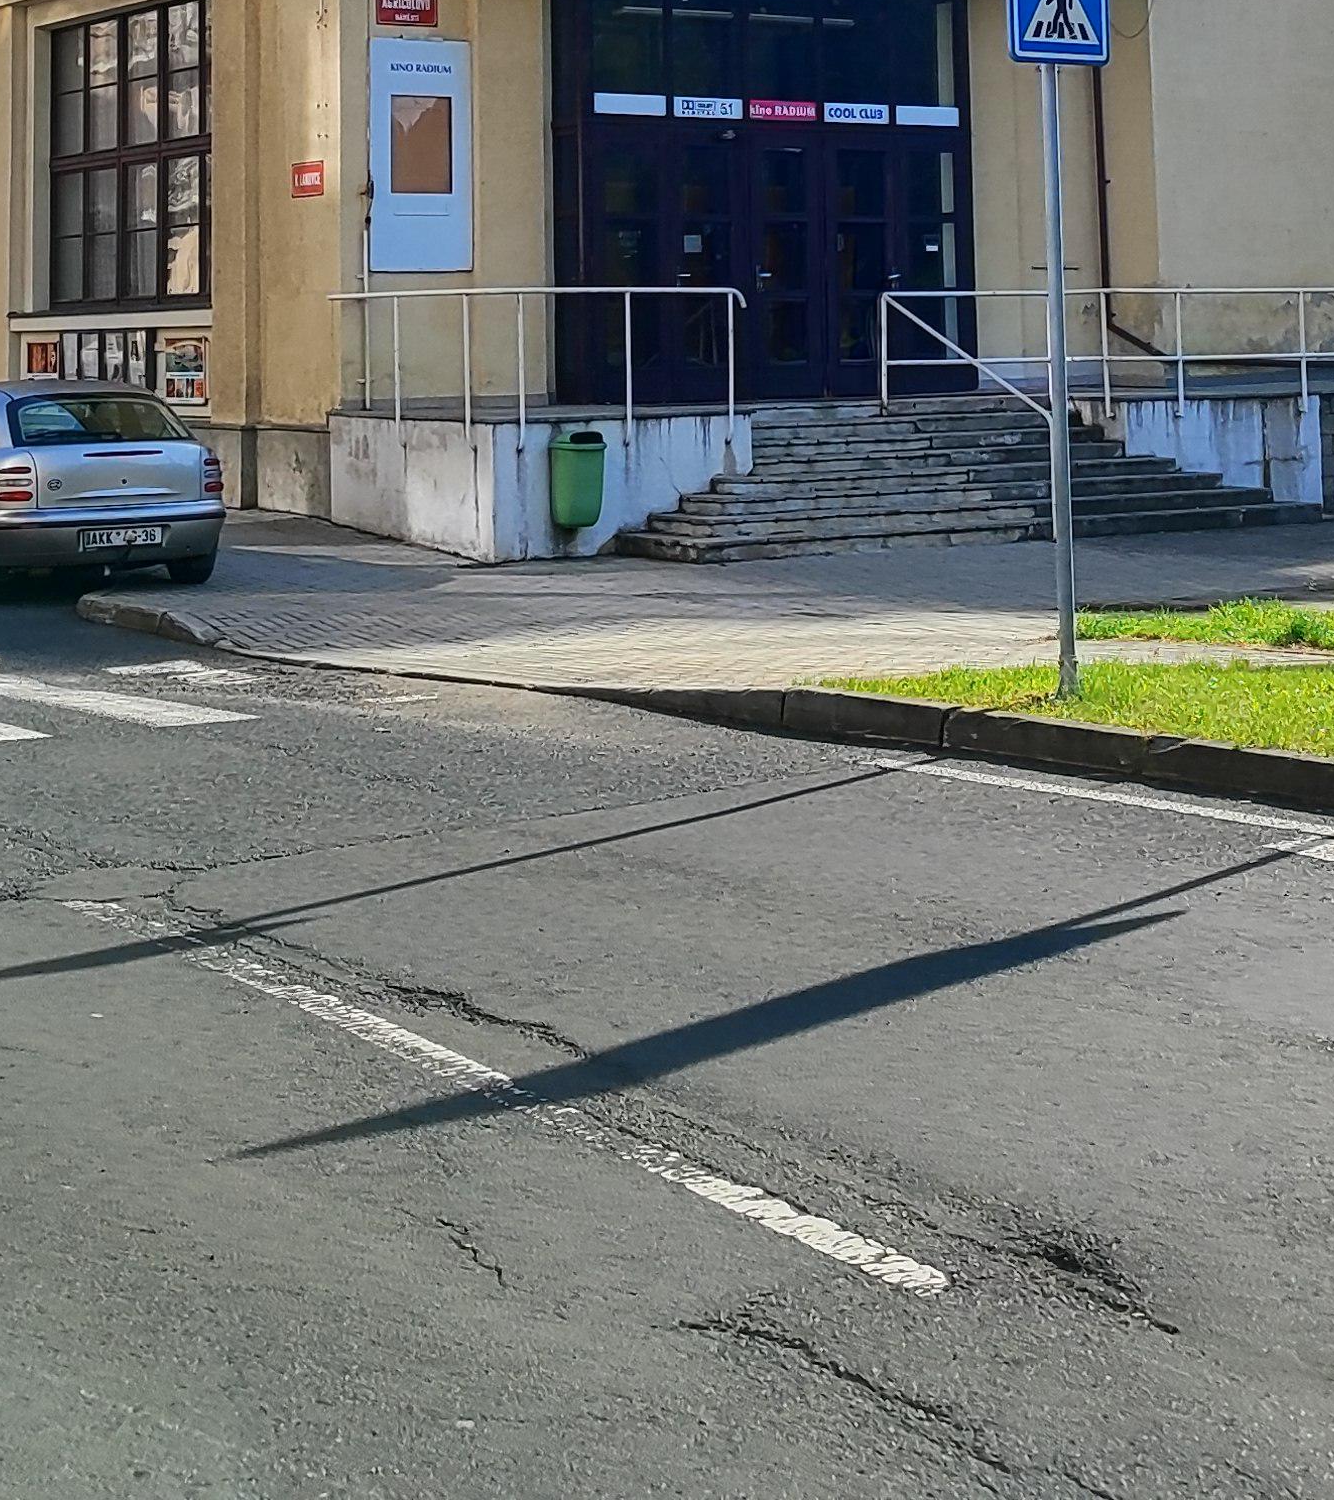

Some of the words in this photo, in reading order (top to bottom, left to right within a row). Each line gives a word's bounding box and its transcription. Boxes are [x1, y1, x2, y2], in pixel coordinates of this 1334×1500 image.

[390, 63, 413, 72] KINO
[415, 63, 452, 74] RADIUM
[828, 107, 856, 119] COOL
[858, 108, 884, 120] CLUB
